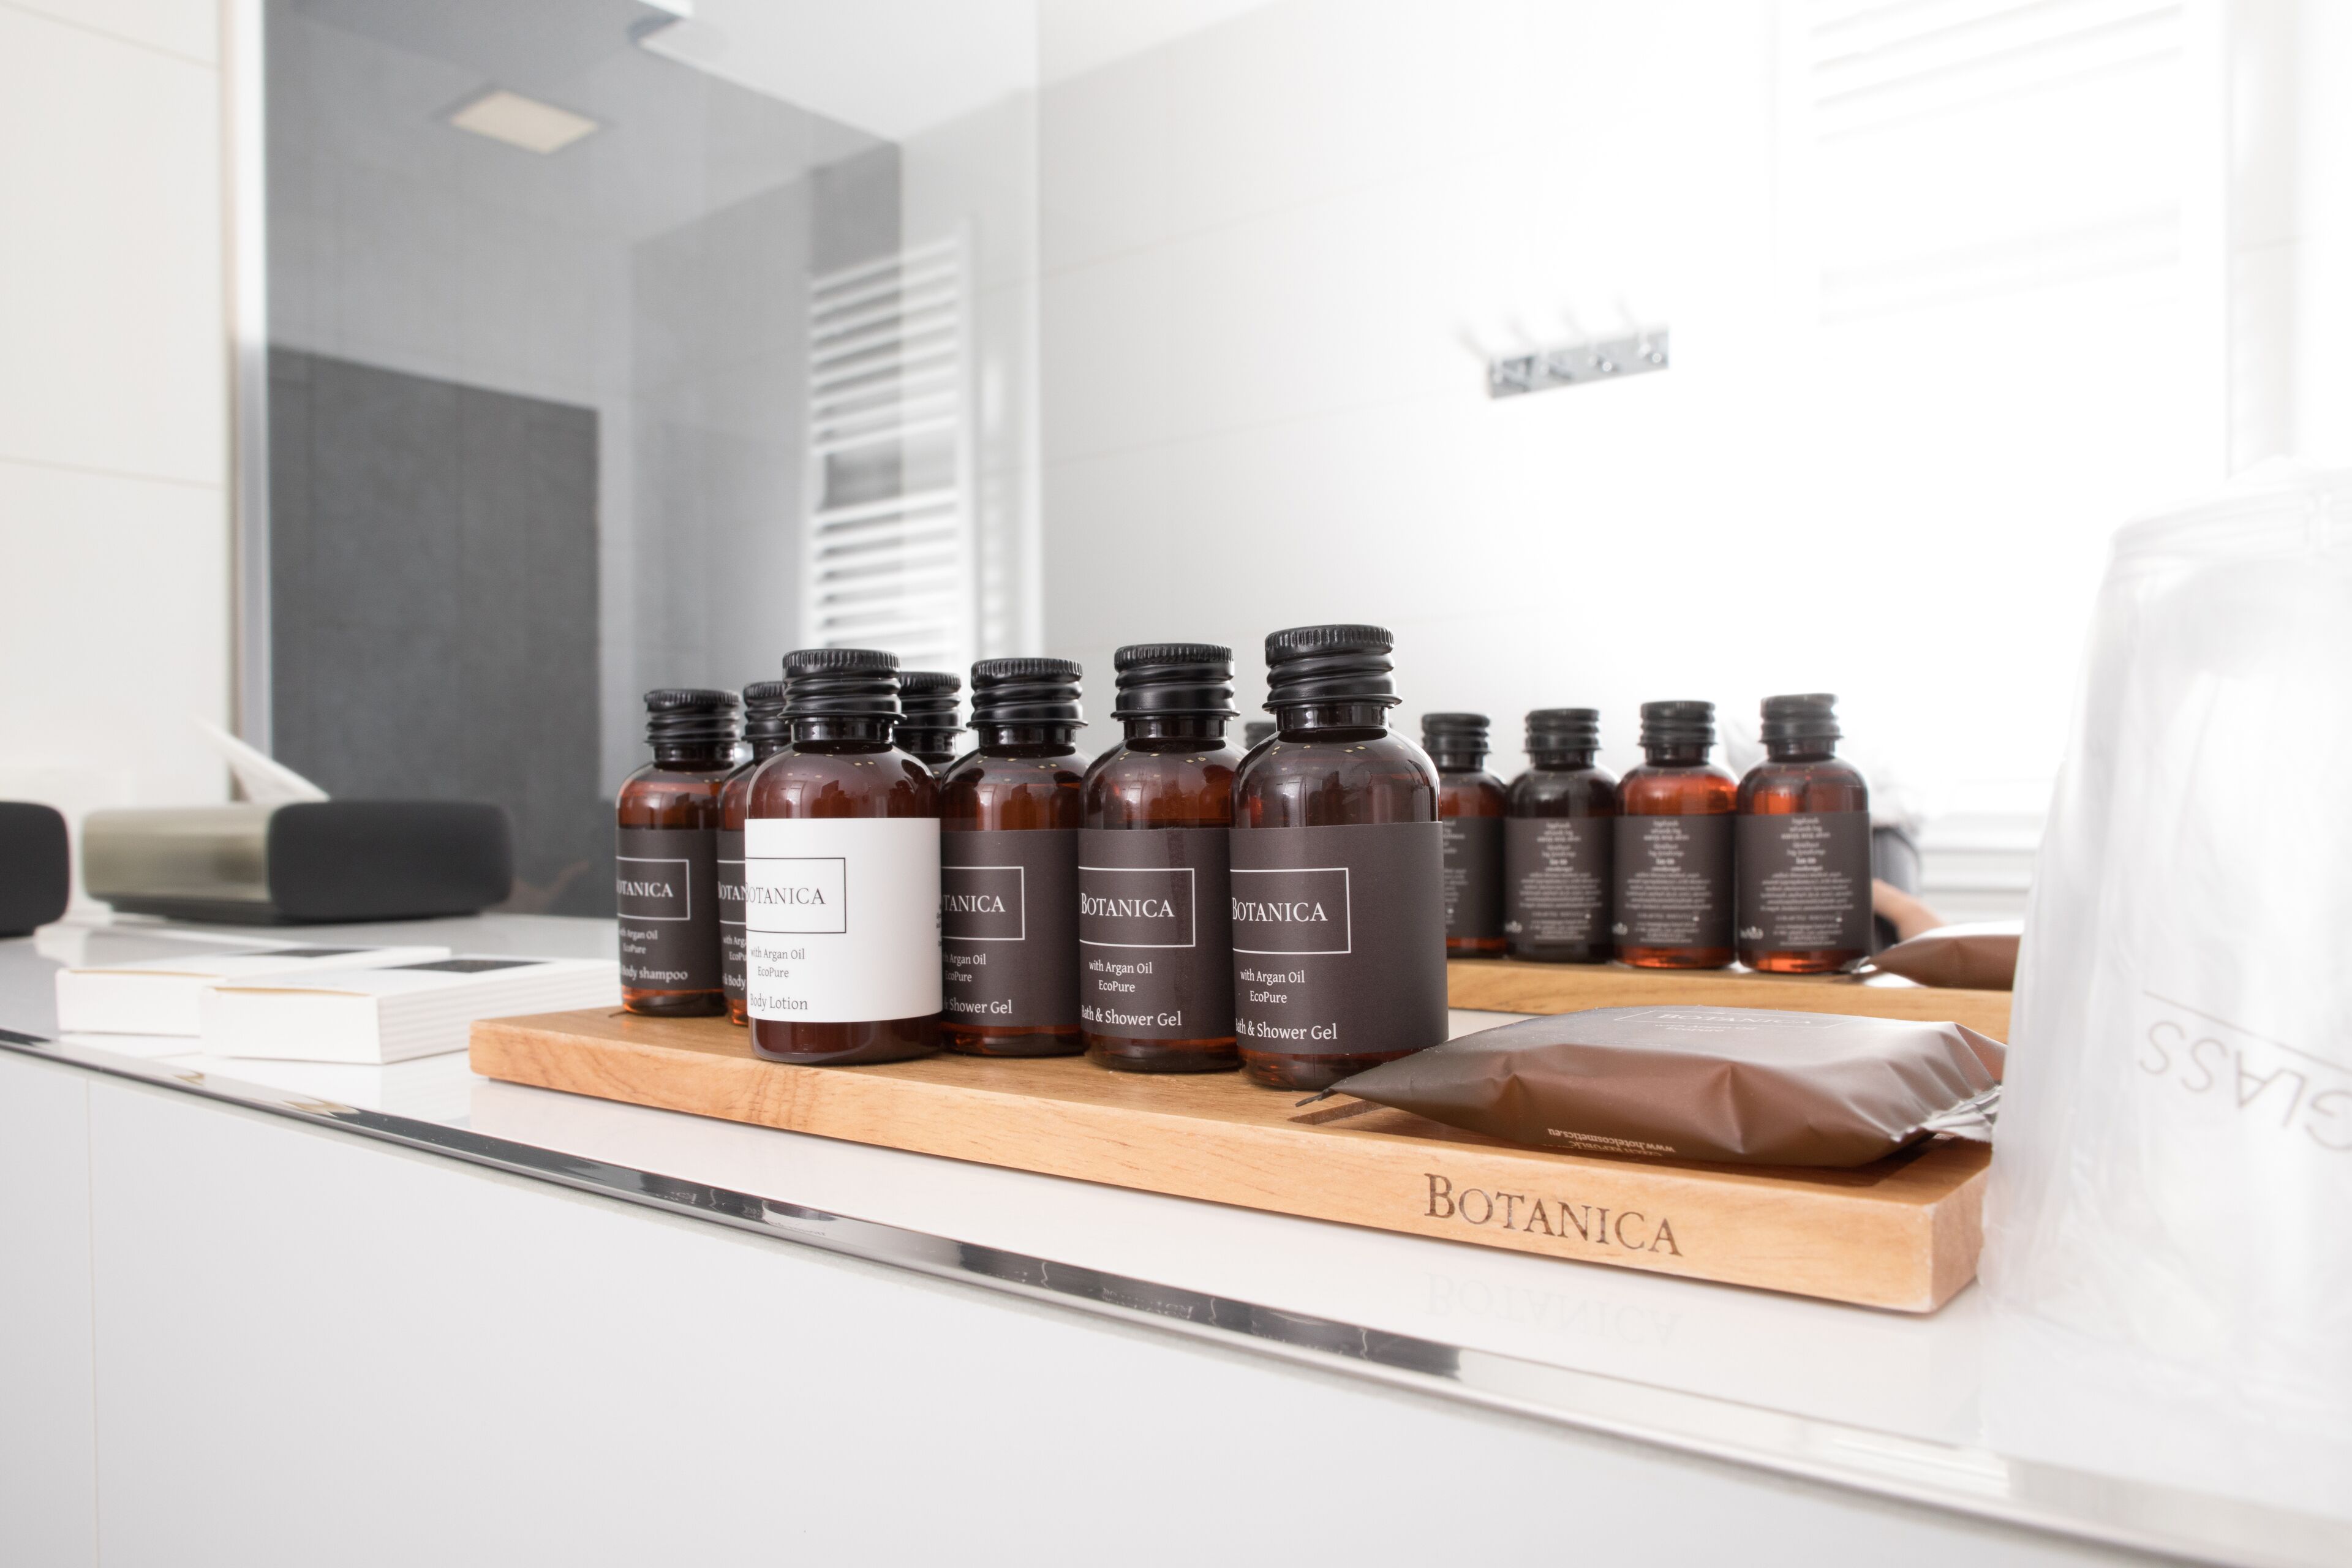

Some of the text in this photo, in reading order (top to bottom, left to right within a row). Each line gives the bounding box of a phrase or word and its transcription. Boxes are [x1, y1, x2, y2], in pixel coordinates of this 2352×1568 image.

[617, 879, 673, 897] OTANICA
[943, 894, 1006, 912] TANICA
[1081, 892, 1175, 918] BOTANICA
[1232, 897, 1329, 922] BOTANICA
[646, 930, 658, 940] Oil
[733, 937, 747, 948] Arg
[729, 951, 747, 962] EcoPu
[750, 946, 805, 962] with Argan Oil
[950, 954, 971, 967] Argan
[973, 953, 987, 965] Oil
[639, 966, 688, 982] shampoo
[758, 966, 789, 978] EcoPure
[945, 970, 972, 982] EcoPure
[1088, 959, 1153, 976] with Argan Oil
[728, 974, 746, 990] Body
[1098, 979, 1136, 992] EcoPure
[1240, 968, 1305, 986] with Argan Oil
[750, 993, 808, 1011] Body Lotion
[1250, 990, 1287, 1003] EcoPure
[950, 997, 987, 1013] Shower
[990, 999, 1012, 1014] Gel
[1081, 1005, 1182, 1026] Bath & Shower Gel
[1247, 1020, 1255, 1036] &
[1257, 1021, 1306, 1039] Shower
[1311, 1022, 1338, 1039] Gel
[2138, 1020, 2352, 1152] GLASS
[1548, 1128, 1676, 1153] www.hotelcosmetics.eu
[1423, 1172, 1683, 1257] BOTANICA
